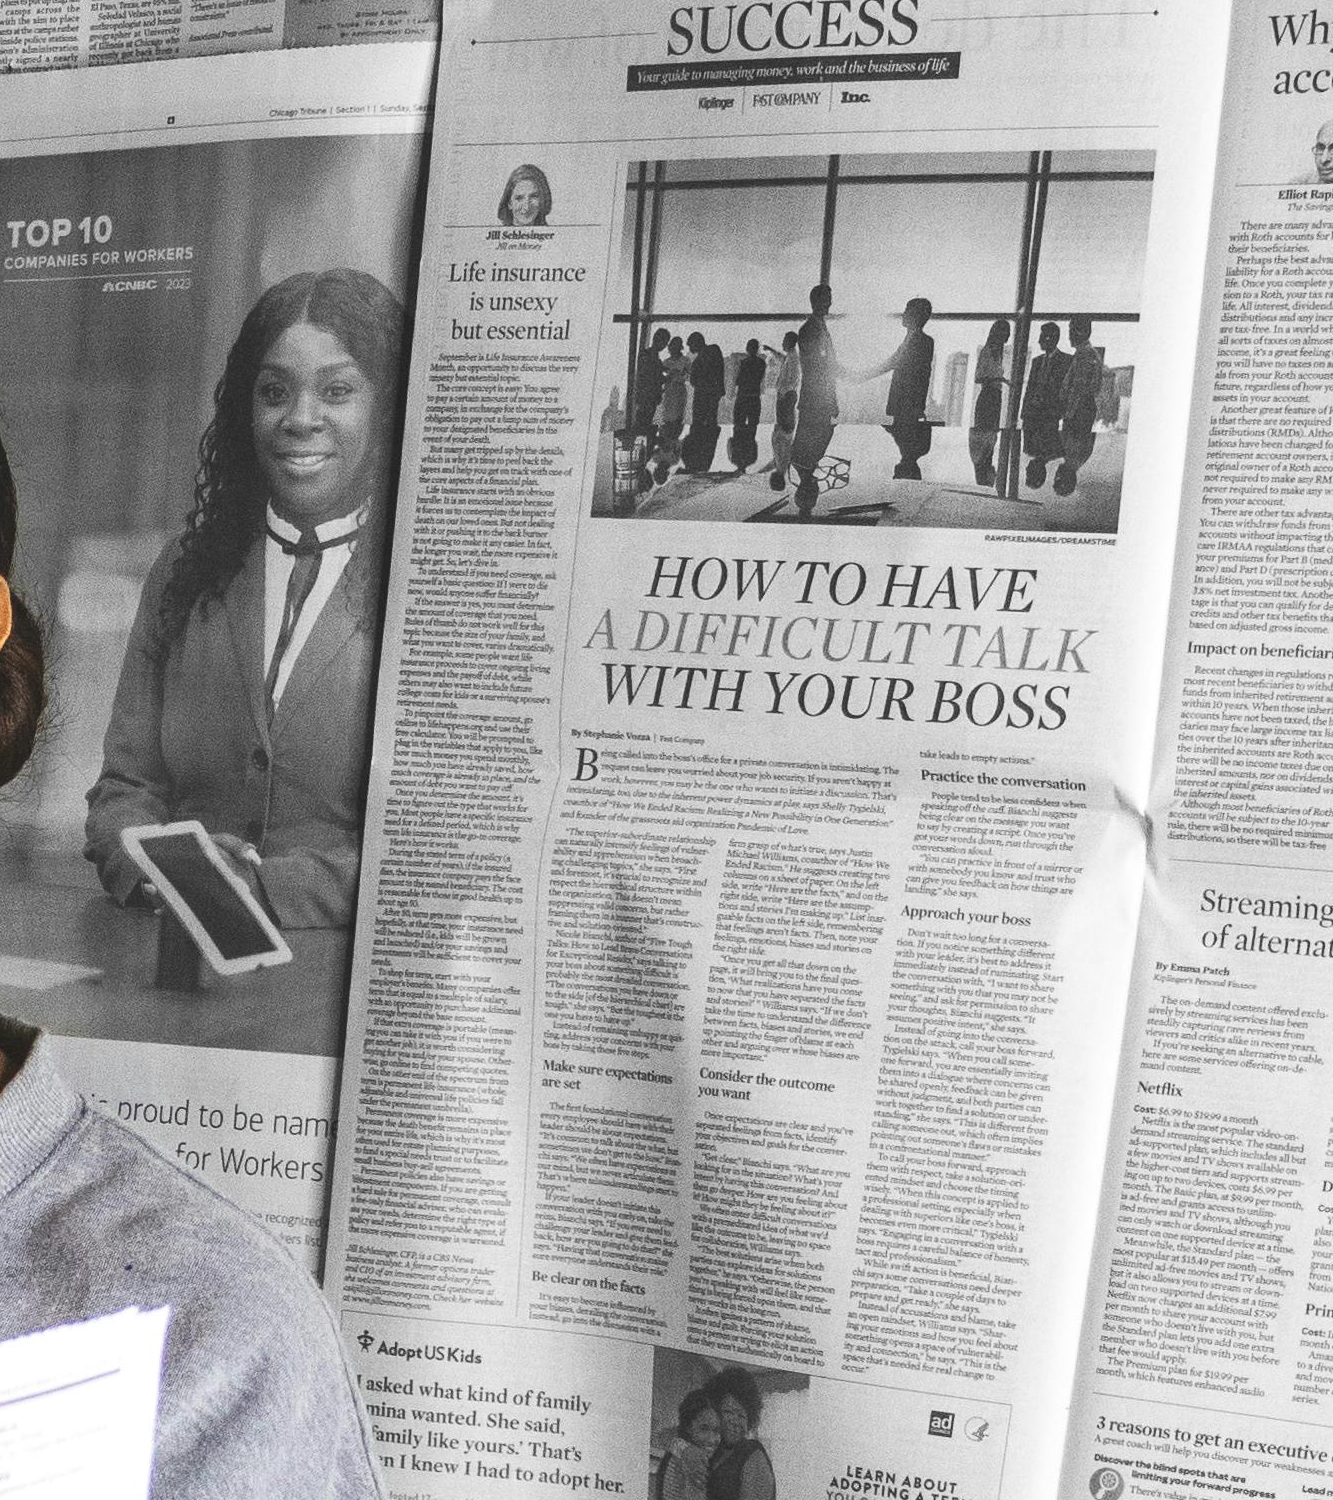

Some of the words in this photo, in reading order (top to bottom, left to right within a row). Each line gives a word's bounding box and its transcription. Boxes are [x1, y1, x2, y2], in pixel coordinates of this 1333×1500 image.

[4, 254, 87, 269] COMPANIES
[92, 251, 119, 264] FOR
[124, 246, 193, 262] WORKERS
[7, 218, 72, 247] TOP
[79, 215, 113, 243] 10
[647, 555, 784, 600] HOW
[796, 561, 868, 605] TO
[880, 563, 1038, 613] HAVE
[584, 608, 617, 651] A
[632, 609, 932, 665] DIFFICULT
[945, 623, 1100, 676] TALK
[604, 662, 748, 712] WITH
[767, 671, 915, 722] YOUR
[929, 680, 1071, 730] BOSS
